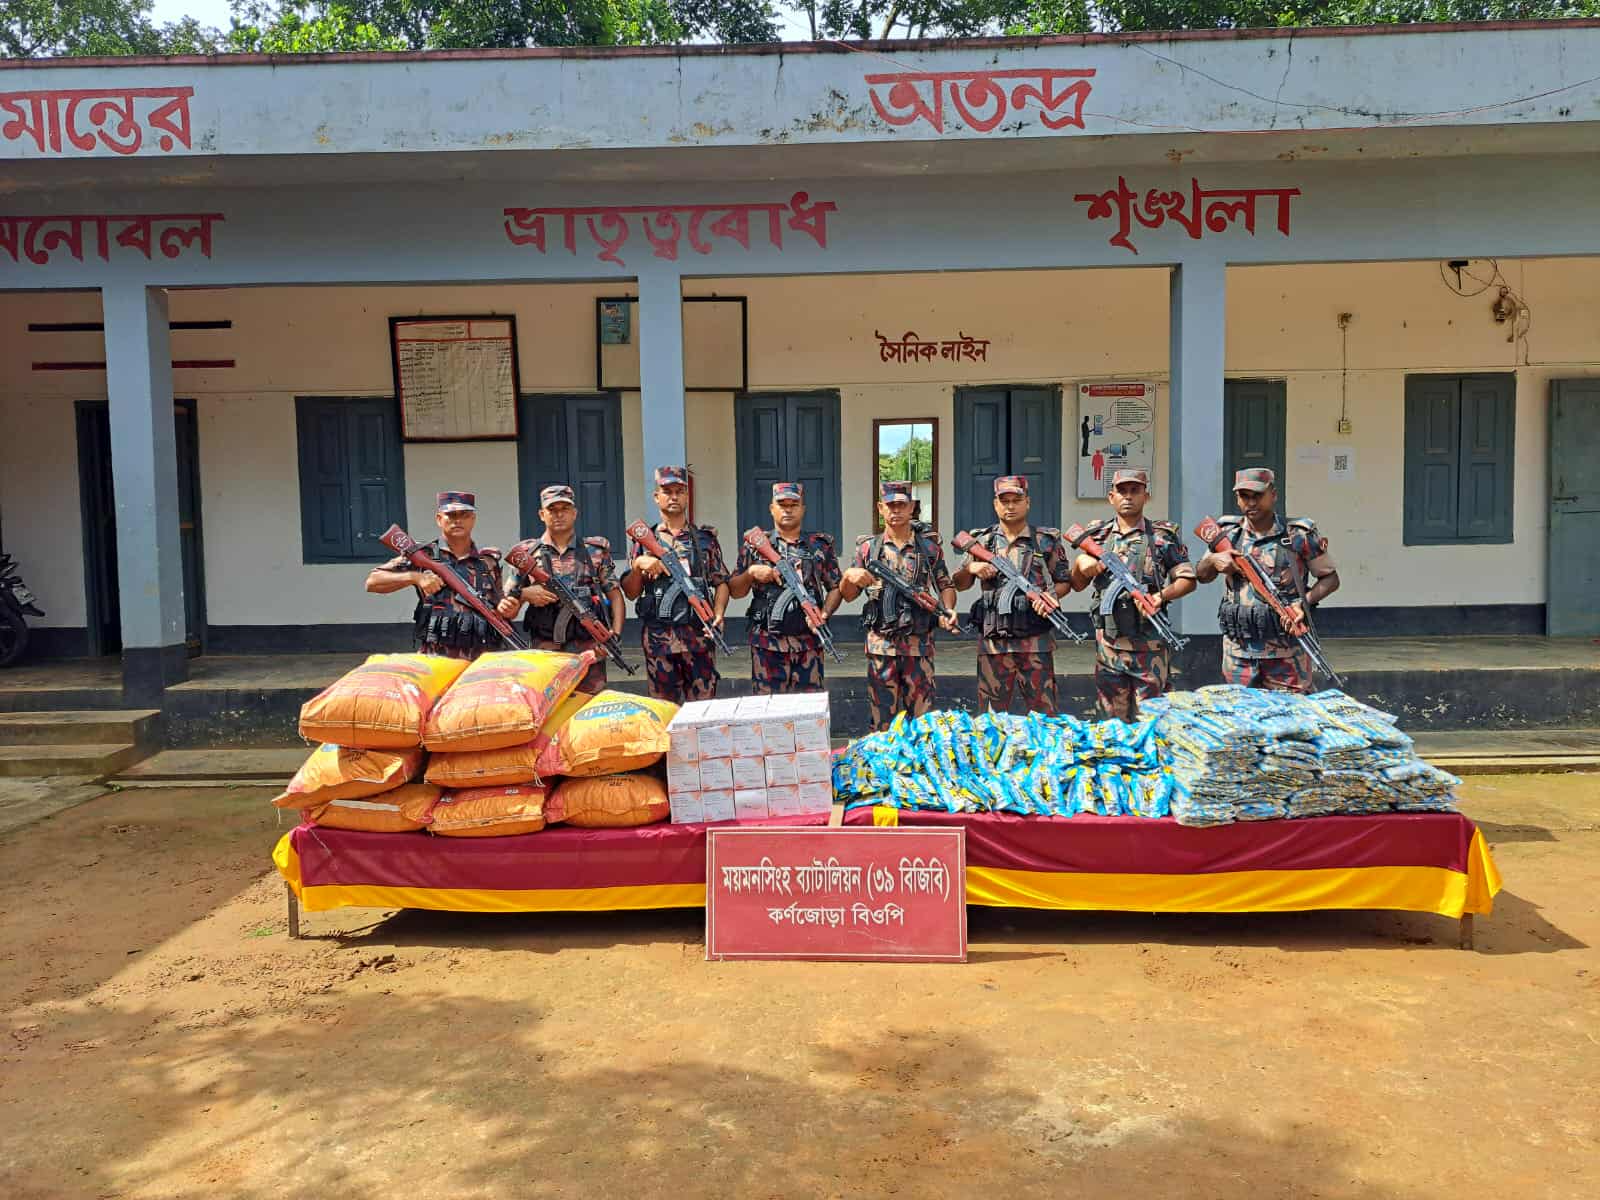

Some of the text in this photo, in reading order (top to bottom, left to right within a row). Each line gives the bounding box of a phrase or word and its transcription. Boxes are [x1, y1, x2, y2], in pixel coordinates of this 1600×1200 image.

[864, 69, 1096, 134] অতন্দ্র
[504, 191, 837, 267] ভ্রাতৃত্ববোধ
[1074, 176, 1301, 255] শৃঙ্খলা
[875, 329, 991, 363] সৈনিক লাইন
[721, 857, 950, 903] ময়মনসিংহ ব্যাটালিয়ন (৩৯ বিজিবি)
[766, 901, 904, 928] কর্ণজোড়া বিওপি
